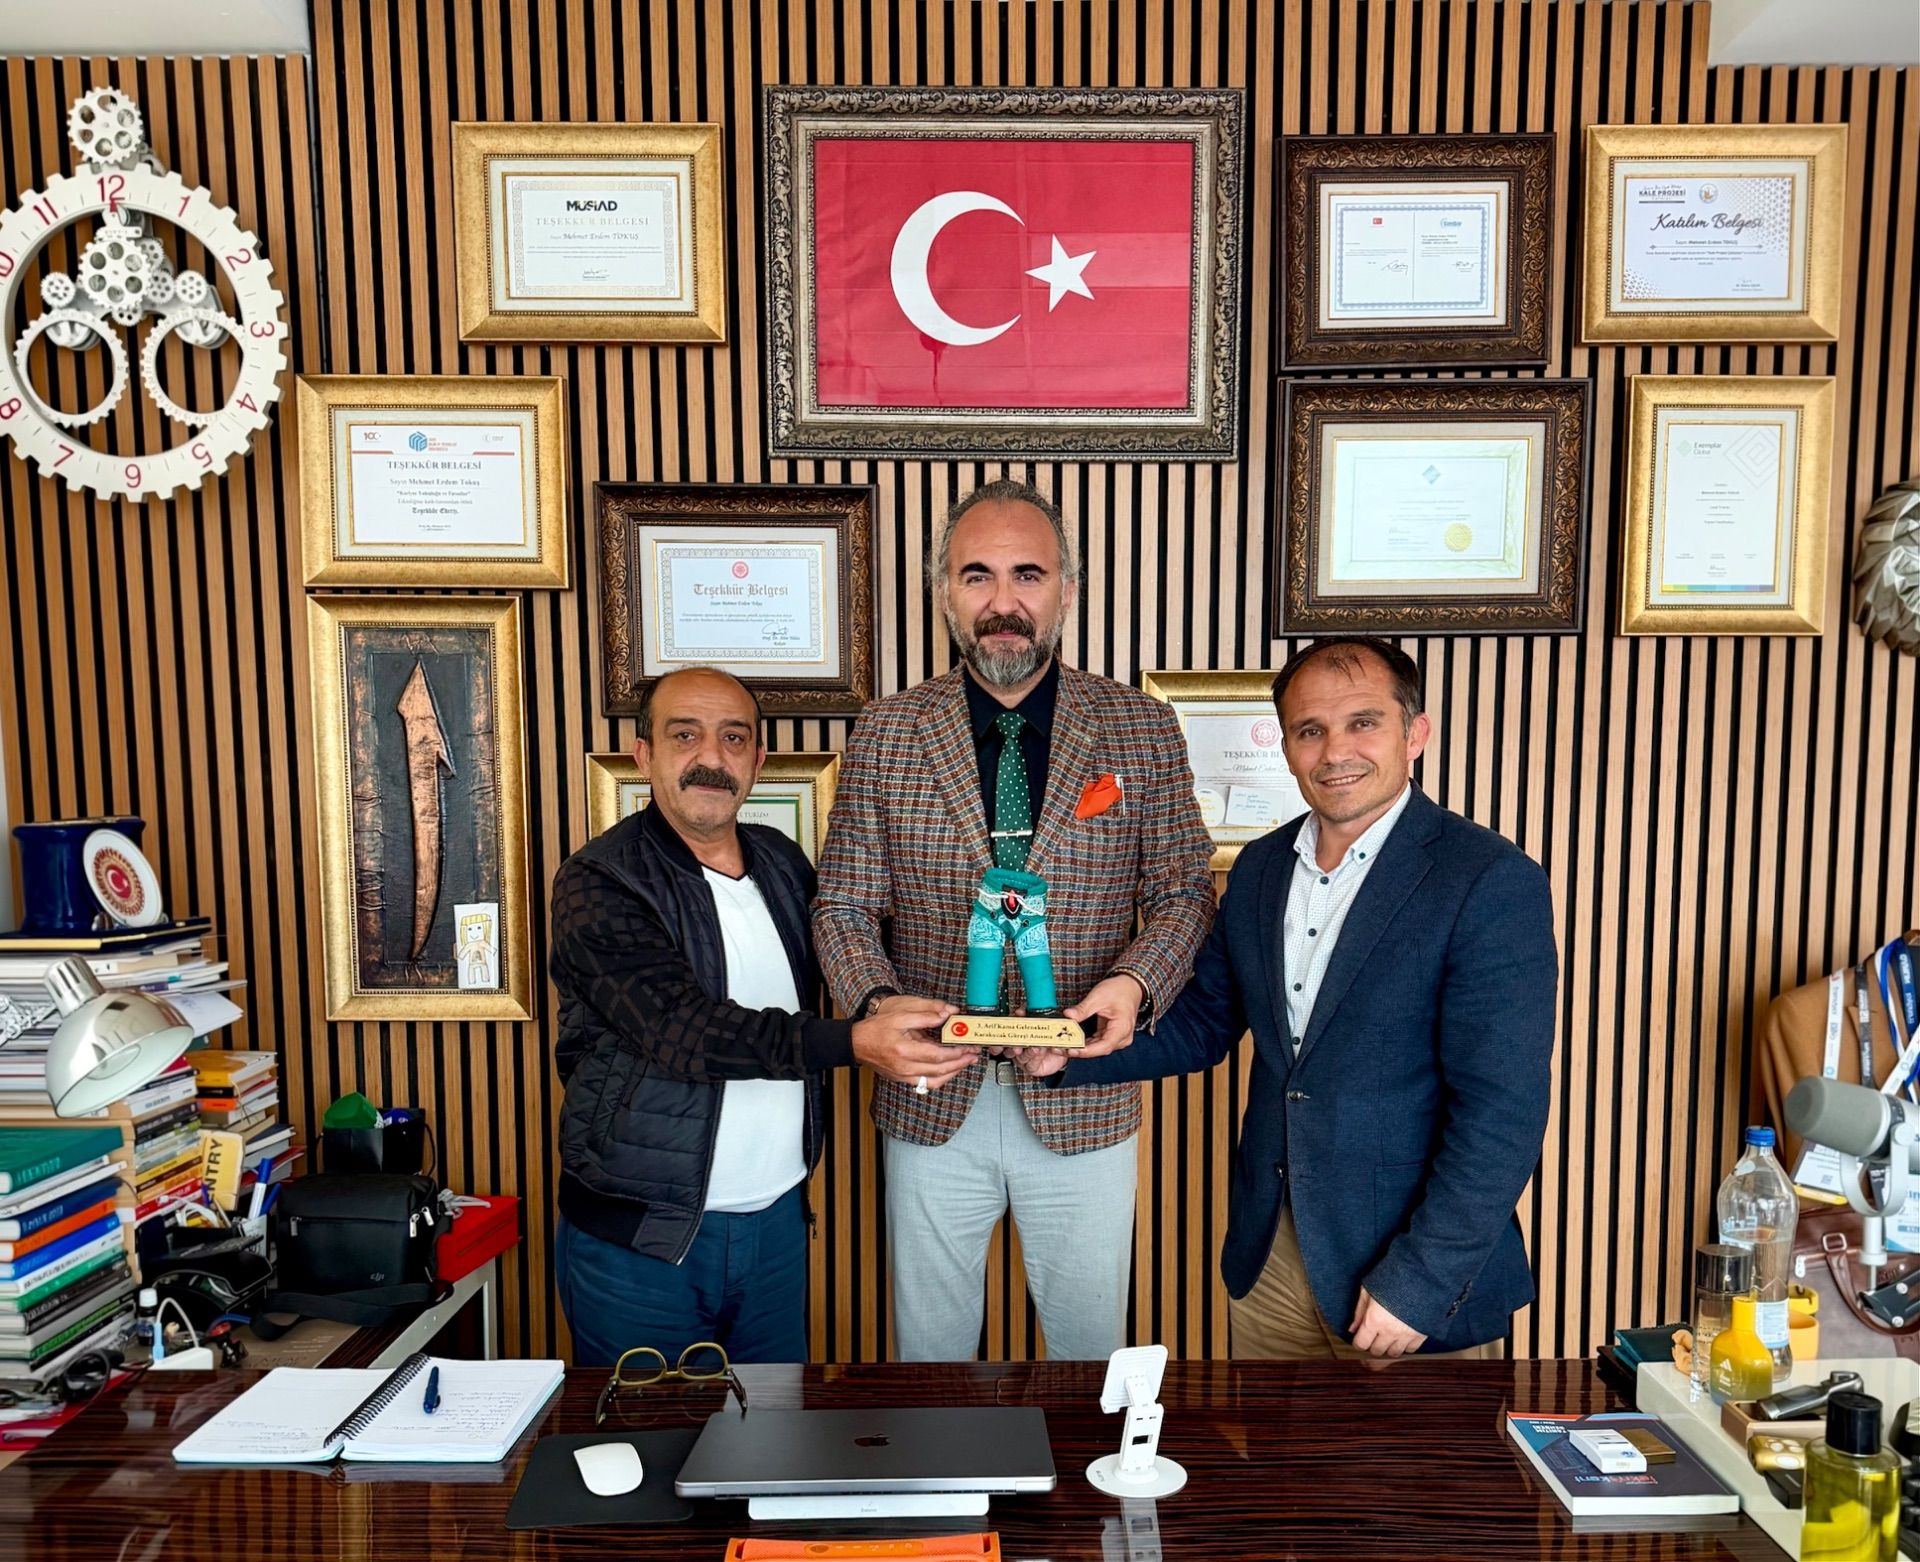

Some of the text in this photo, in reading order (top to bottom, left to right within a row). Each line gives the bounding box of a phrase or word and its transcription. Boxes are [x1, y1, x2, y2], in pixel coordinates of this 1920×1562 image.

[97, 174, 126, 202] 12
[33, 196, 59, 226] 11
[176, 195, 191, 219] 1
[1650, 213, 1764, 236] Katılım Belgesi
[225, 248, 252, 272] 2
[250, 320, 275, 338] 3
[0, 397, 22, 420] 8
[236, 393, 258, 413] 4
[53, 444, 75, 467] 7
[191, 443, 213, 468] 5
[387, 460, 482, 471] TEŞEKKÜR BELGESİ
[693, 584, 789, 599] Teşekkür Belgesi
